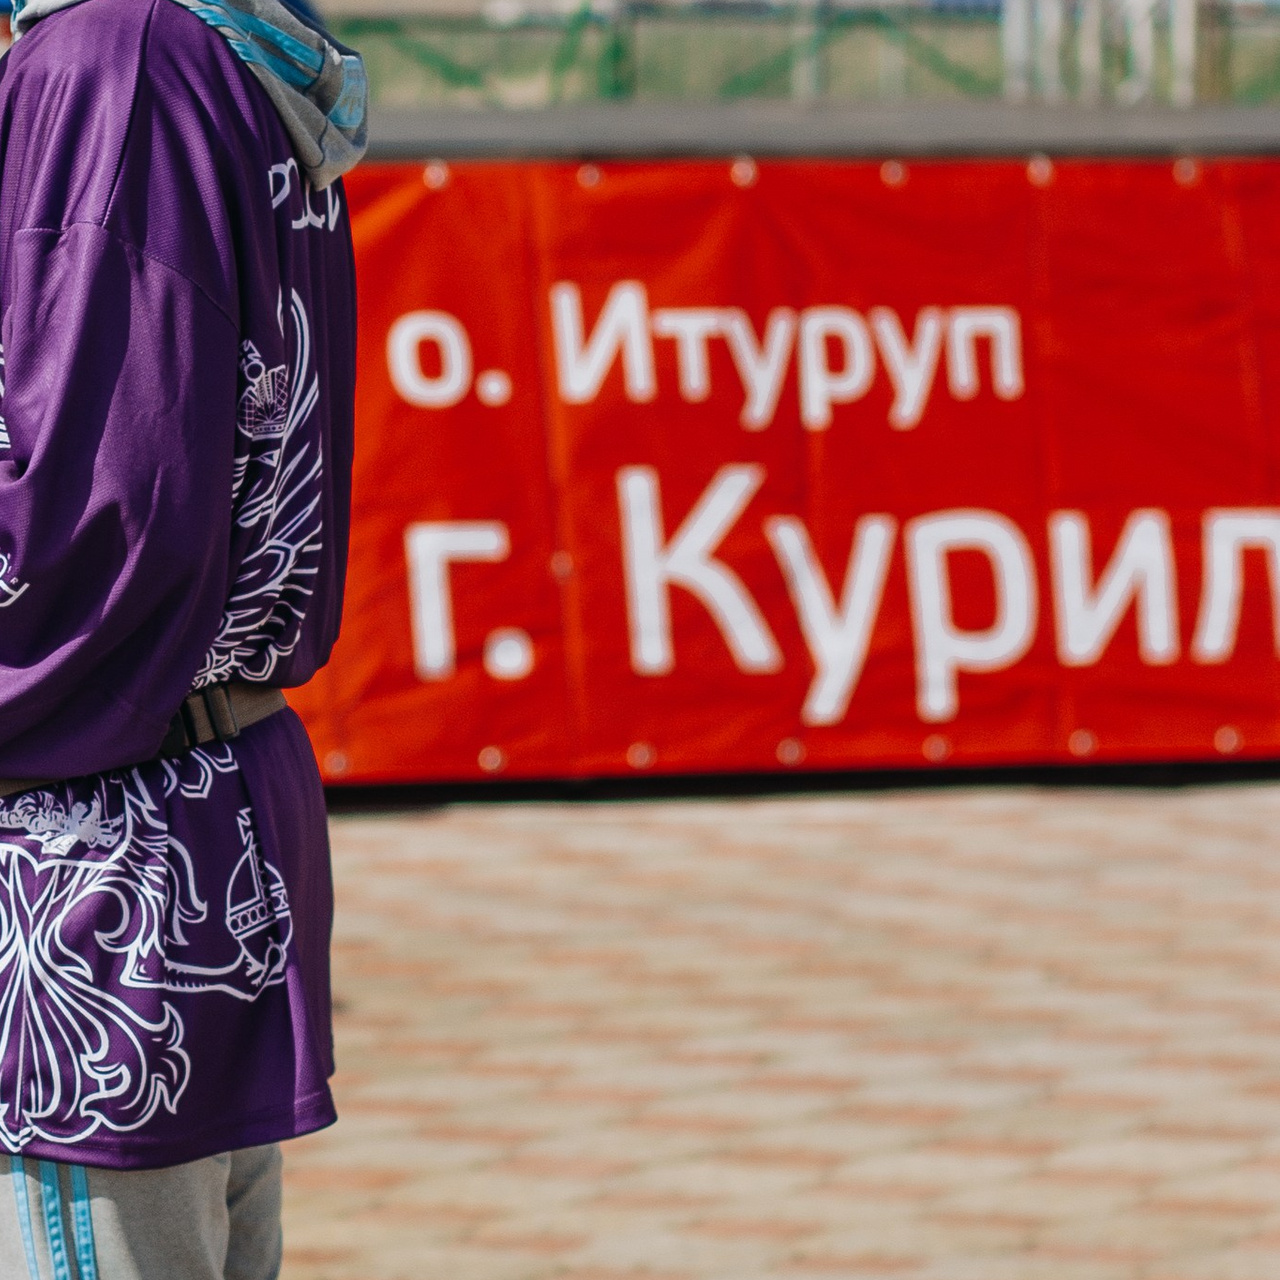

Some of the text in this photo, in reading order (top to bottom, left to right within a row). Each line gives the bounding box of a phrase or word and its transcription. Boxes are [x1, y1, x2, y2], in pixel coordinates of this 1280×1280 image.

[386, 280, 1025, 429] о. Итуруп
[404, 520, 535, 682] г.
